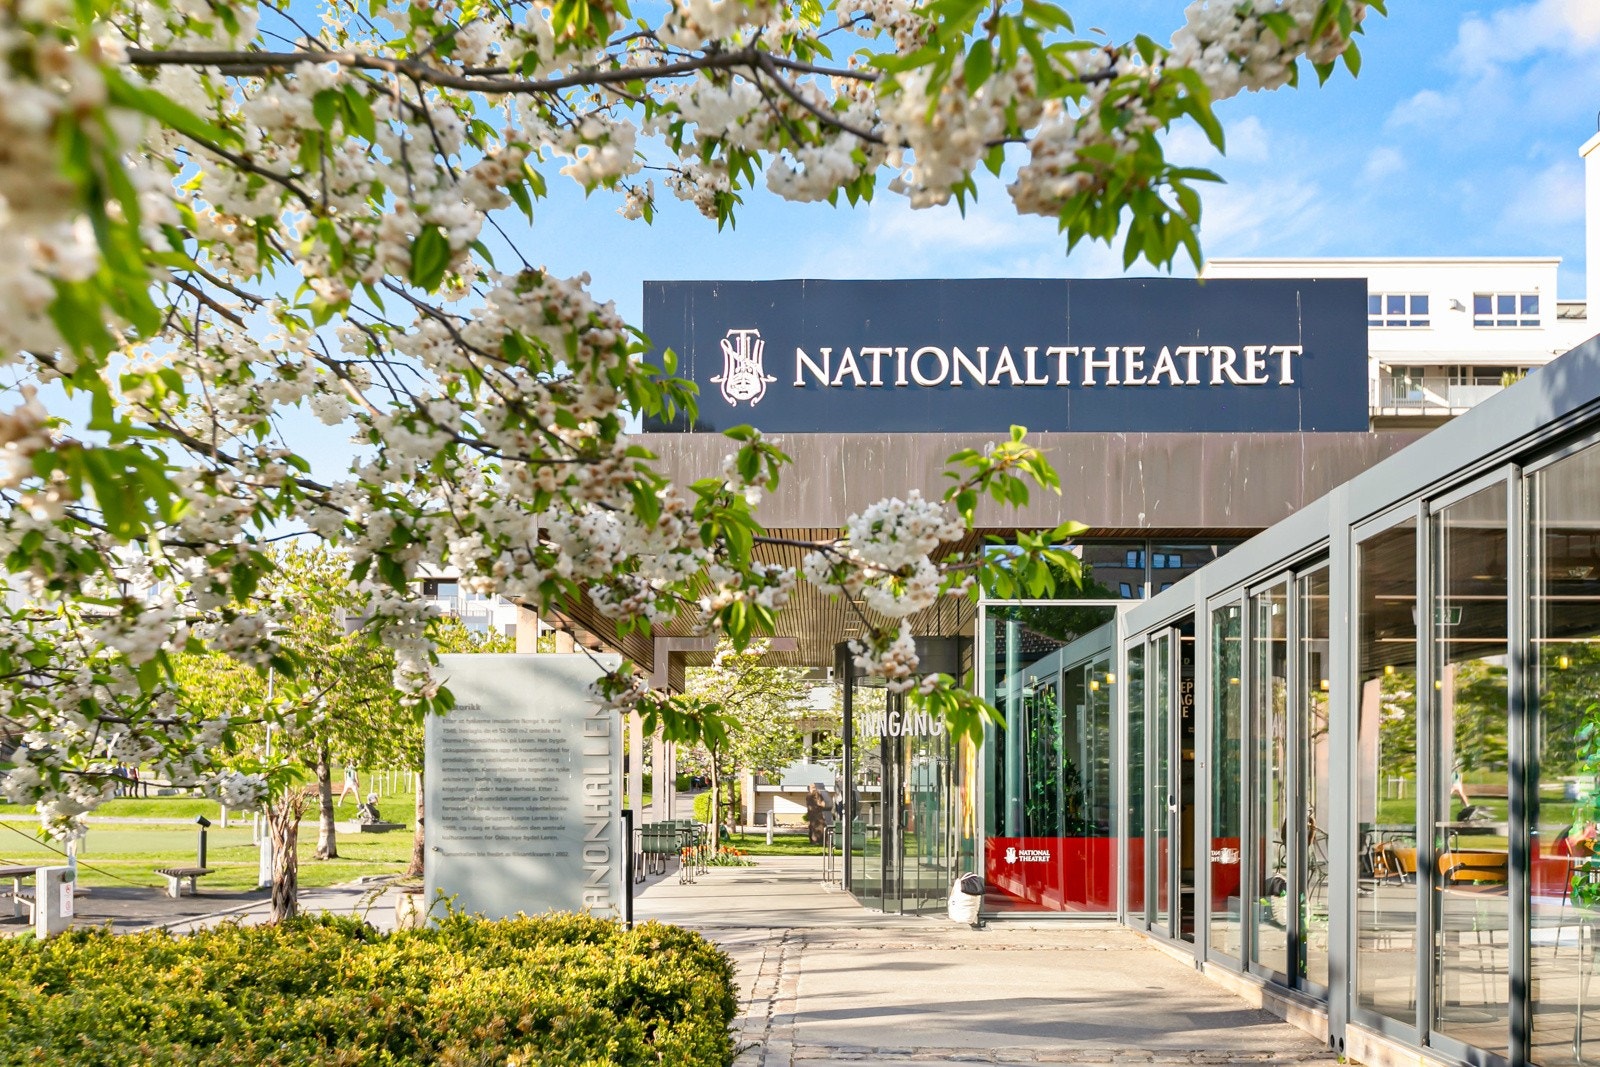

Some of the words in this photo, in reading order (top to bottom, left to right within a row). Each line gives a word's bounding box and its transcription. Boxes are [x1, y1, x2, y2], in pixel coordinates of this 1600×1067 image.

[793, 345, 1304, 387] NATIONALTHEATRET
[860, 711, 942, 738] INNGANG
[582, 699, 611, 910] ANONHALLEN
